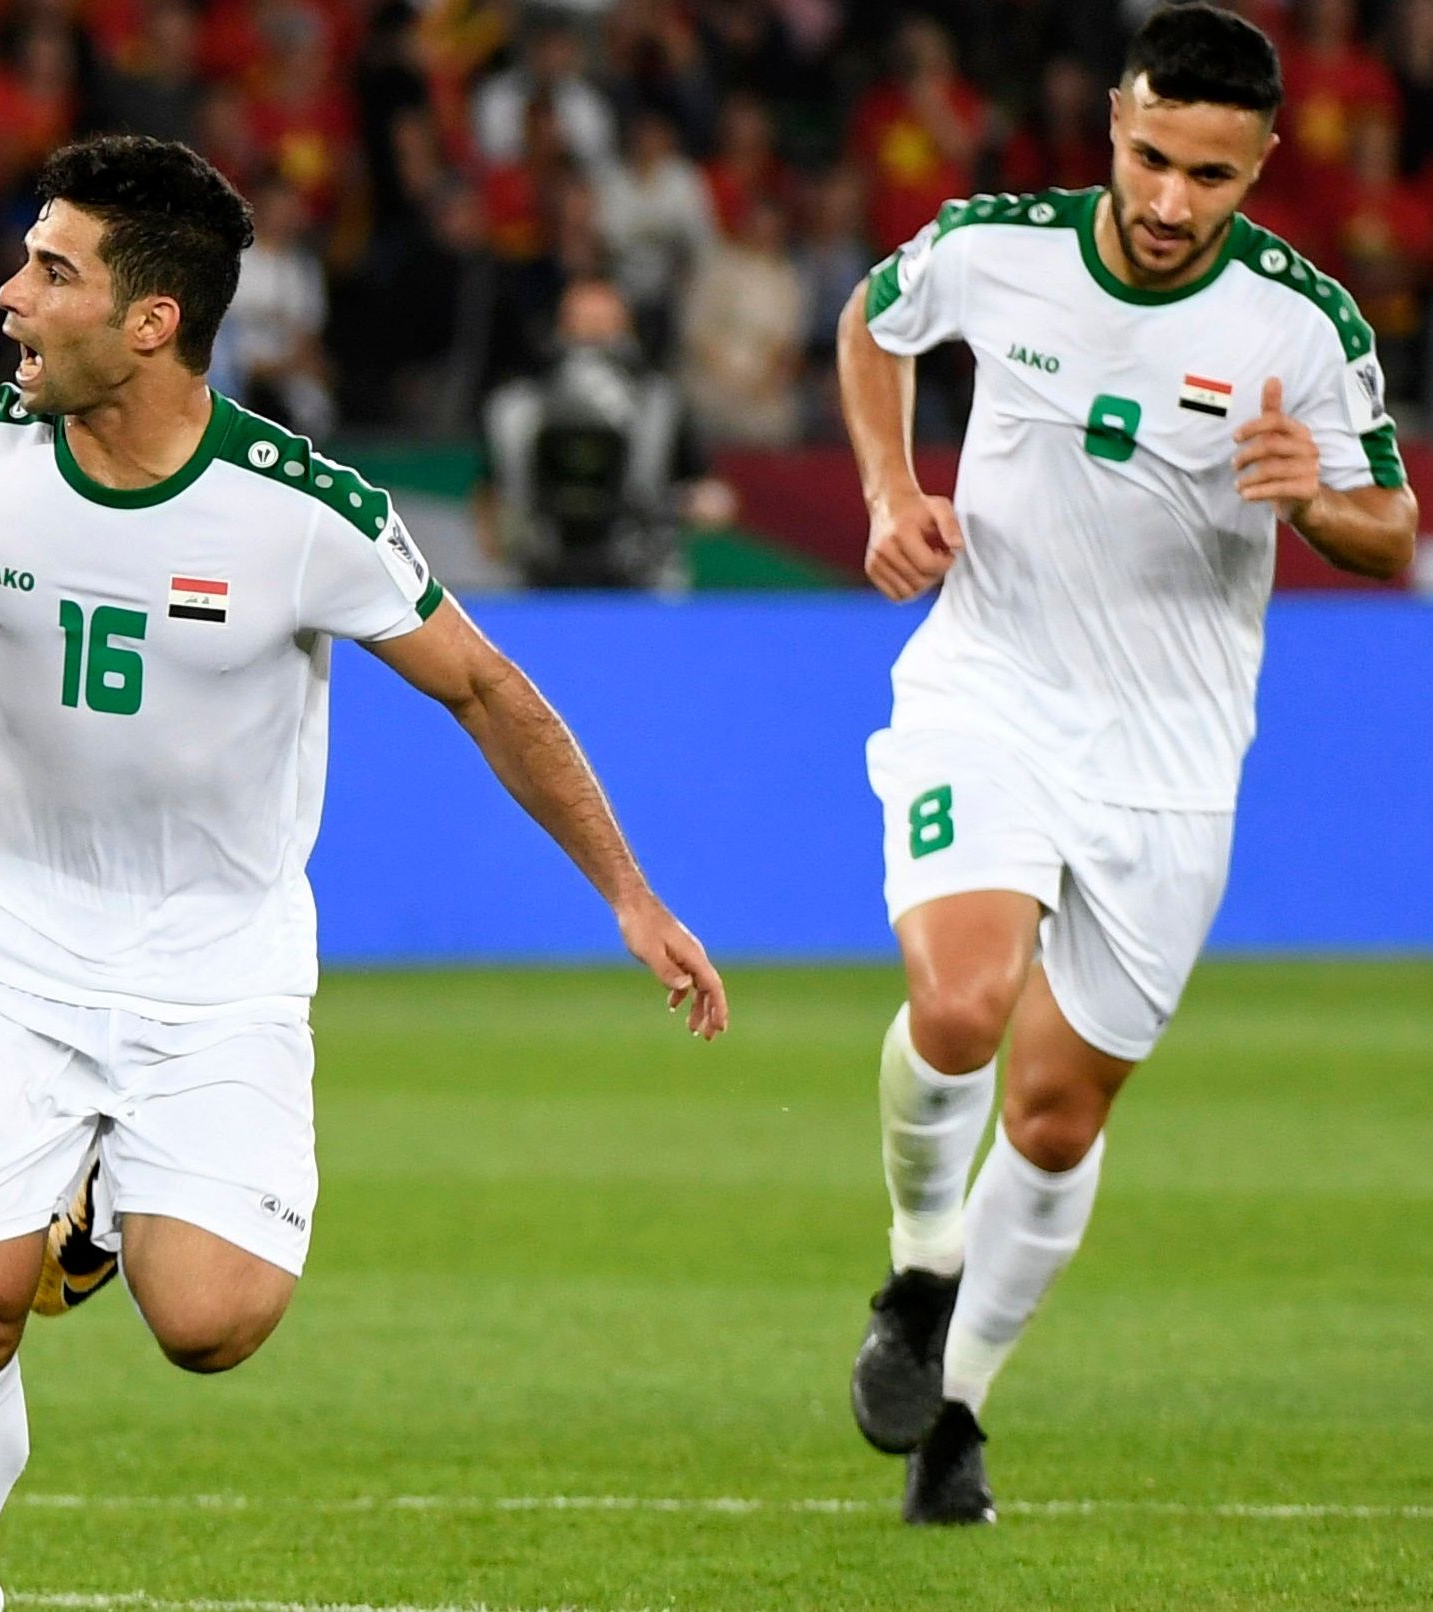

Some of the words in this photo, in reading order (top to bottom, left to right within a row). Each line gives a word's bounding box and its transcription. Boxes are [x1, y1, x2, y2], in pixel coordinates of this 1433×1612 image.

[1007, 343, 1060, 374] JAKO
[59, 599, 148, 716] 16
[909, 785, 955, 859] 8
[280, 1207, 307, 1233] JAKO
